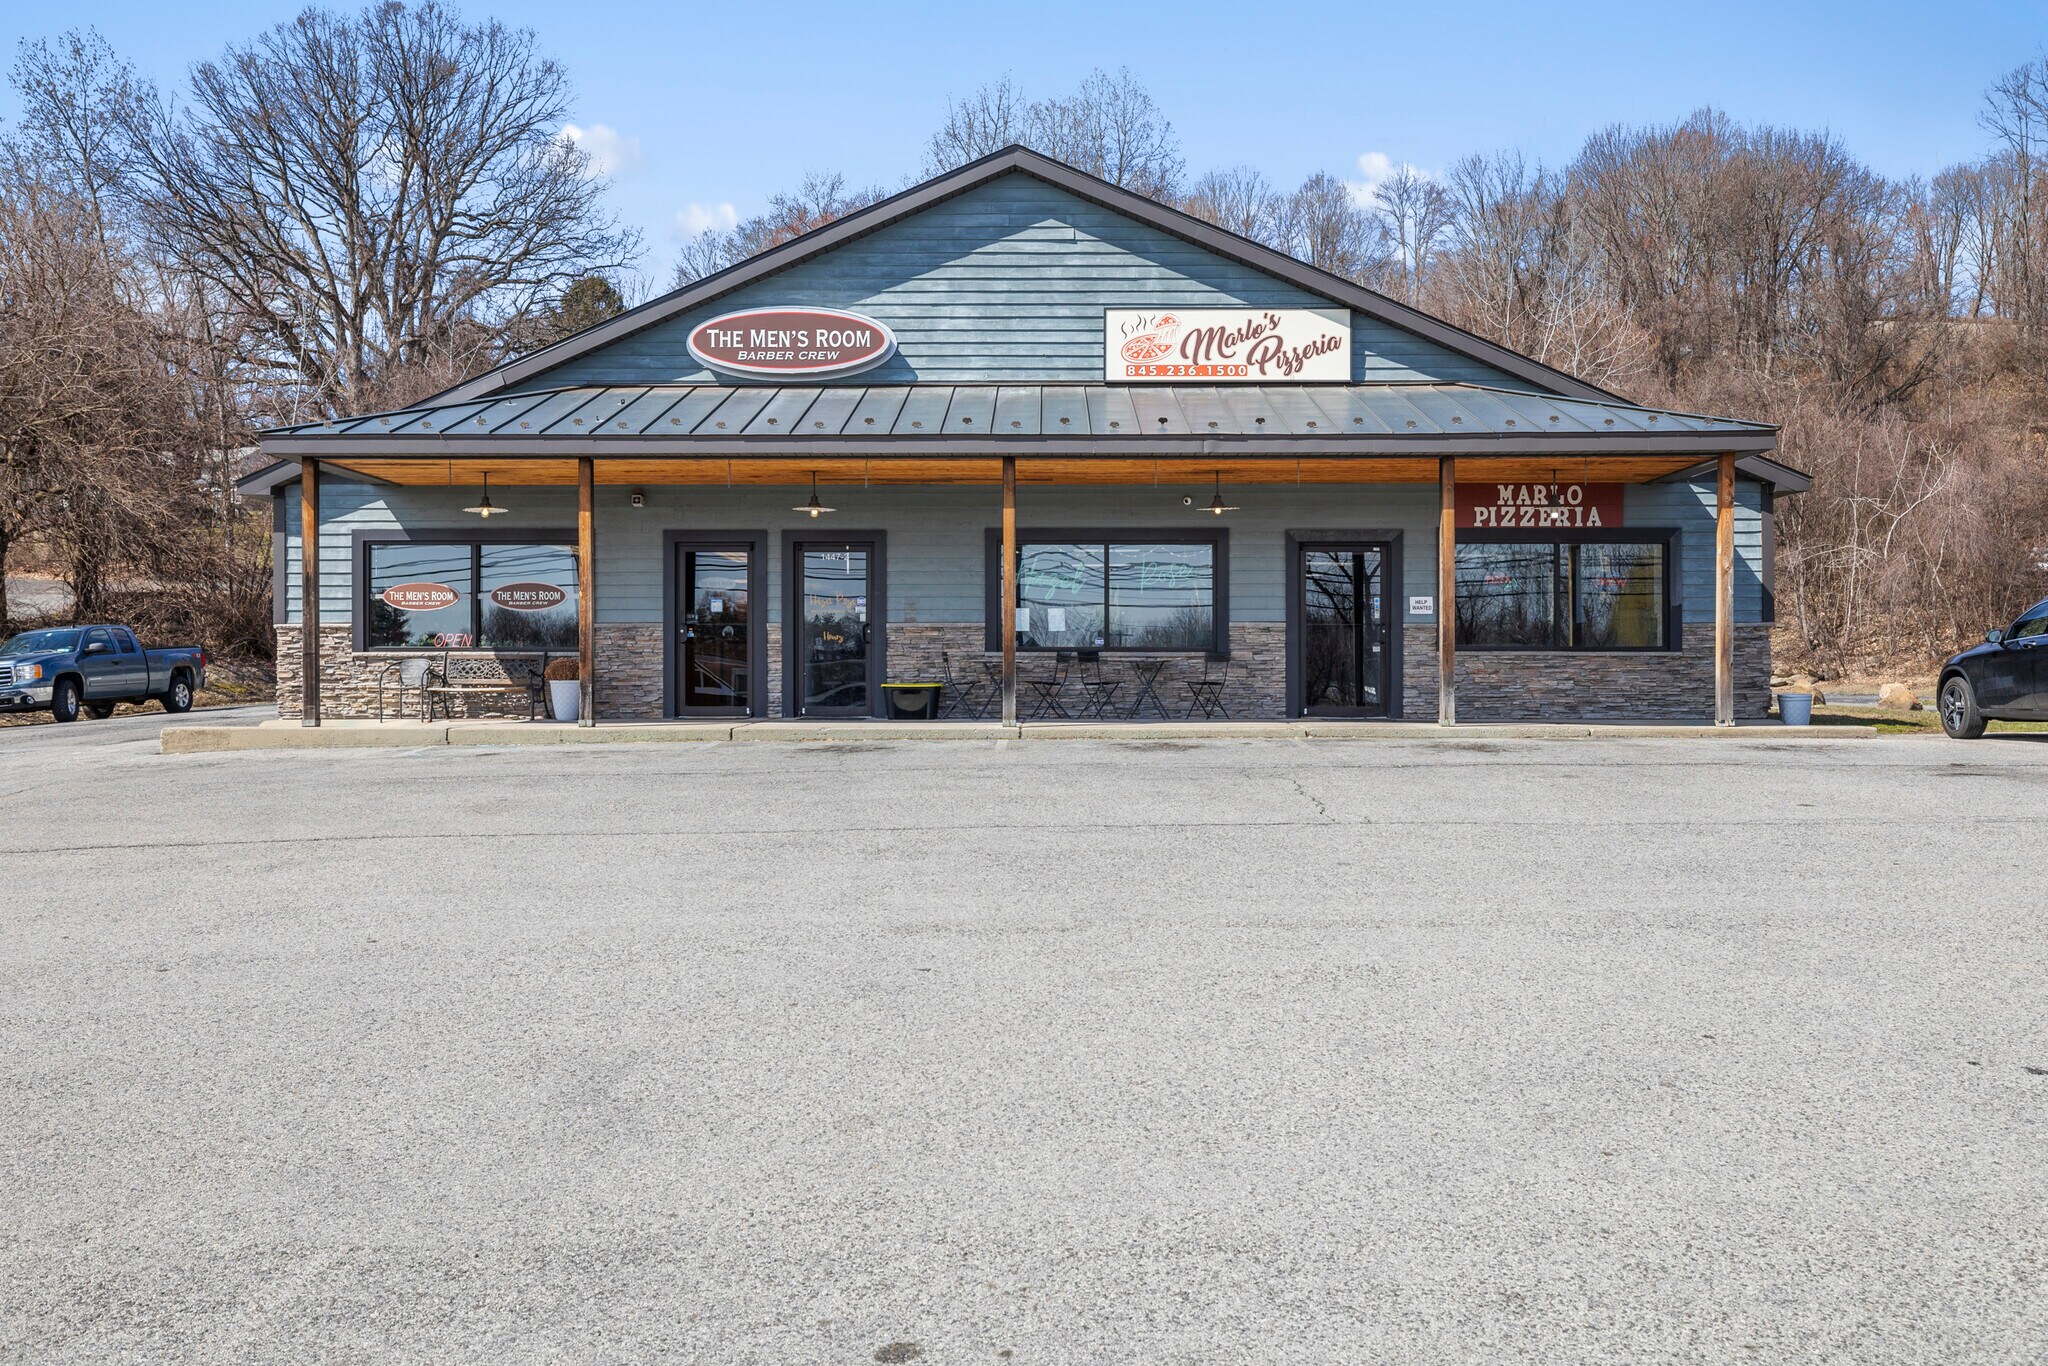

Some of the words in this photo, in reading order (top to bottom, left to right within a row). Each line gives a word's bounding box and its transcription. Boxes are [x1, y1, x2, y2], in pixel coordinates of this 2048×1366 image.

[706, 328, 743, 348] THE
[749, 328, 808, 348] MEN'S
[816, 328, 871, 348] ROOM
[1180, 312, 1281, 366] Marlo's
[737, 351, 794, 360] BARBER
[798, 351, 840, 360] CREW
[1246, 334, 1342, 377] Pizzeria
[1127, 366, 1247, 376] 845.236.1500
[1474, 507, 1601, 527] PIZZERIA
[389, 591, 404, 600] THE
[405, 591, 429, 600] MEN'S
[431, 591, 454, 600] ROOM
[496, 591, 511, 600] THE
[513, 591, 537, 600] MEN'S
[539, 591, 561, 600] ROOM
[433, 633, 473, 648] OPEN
